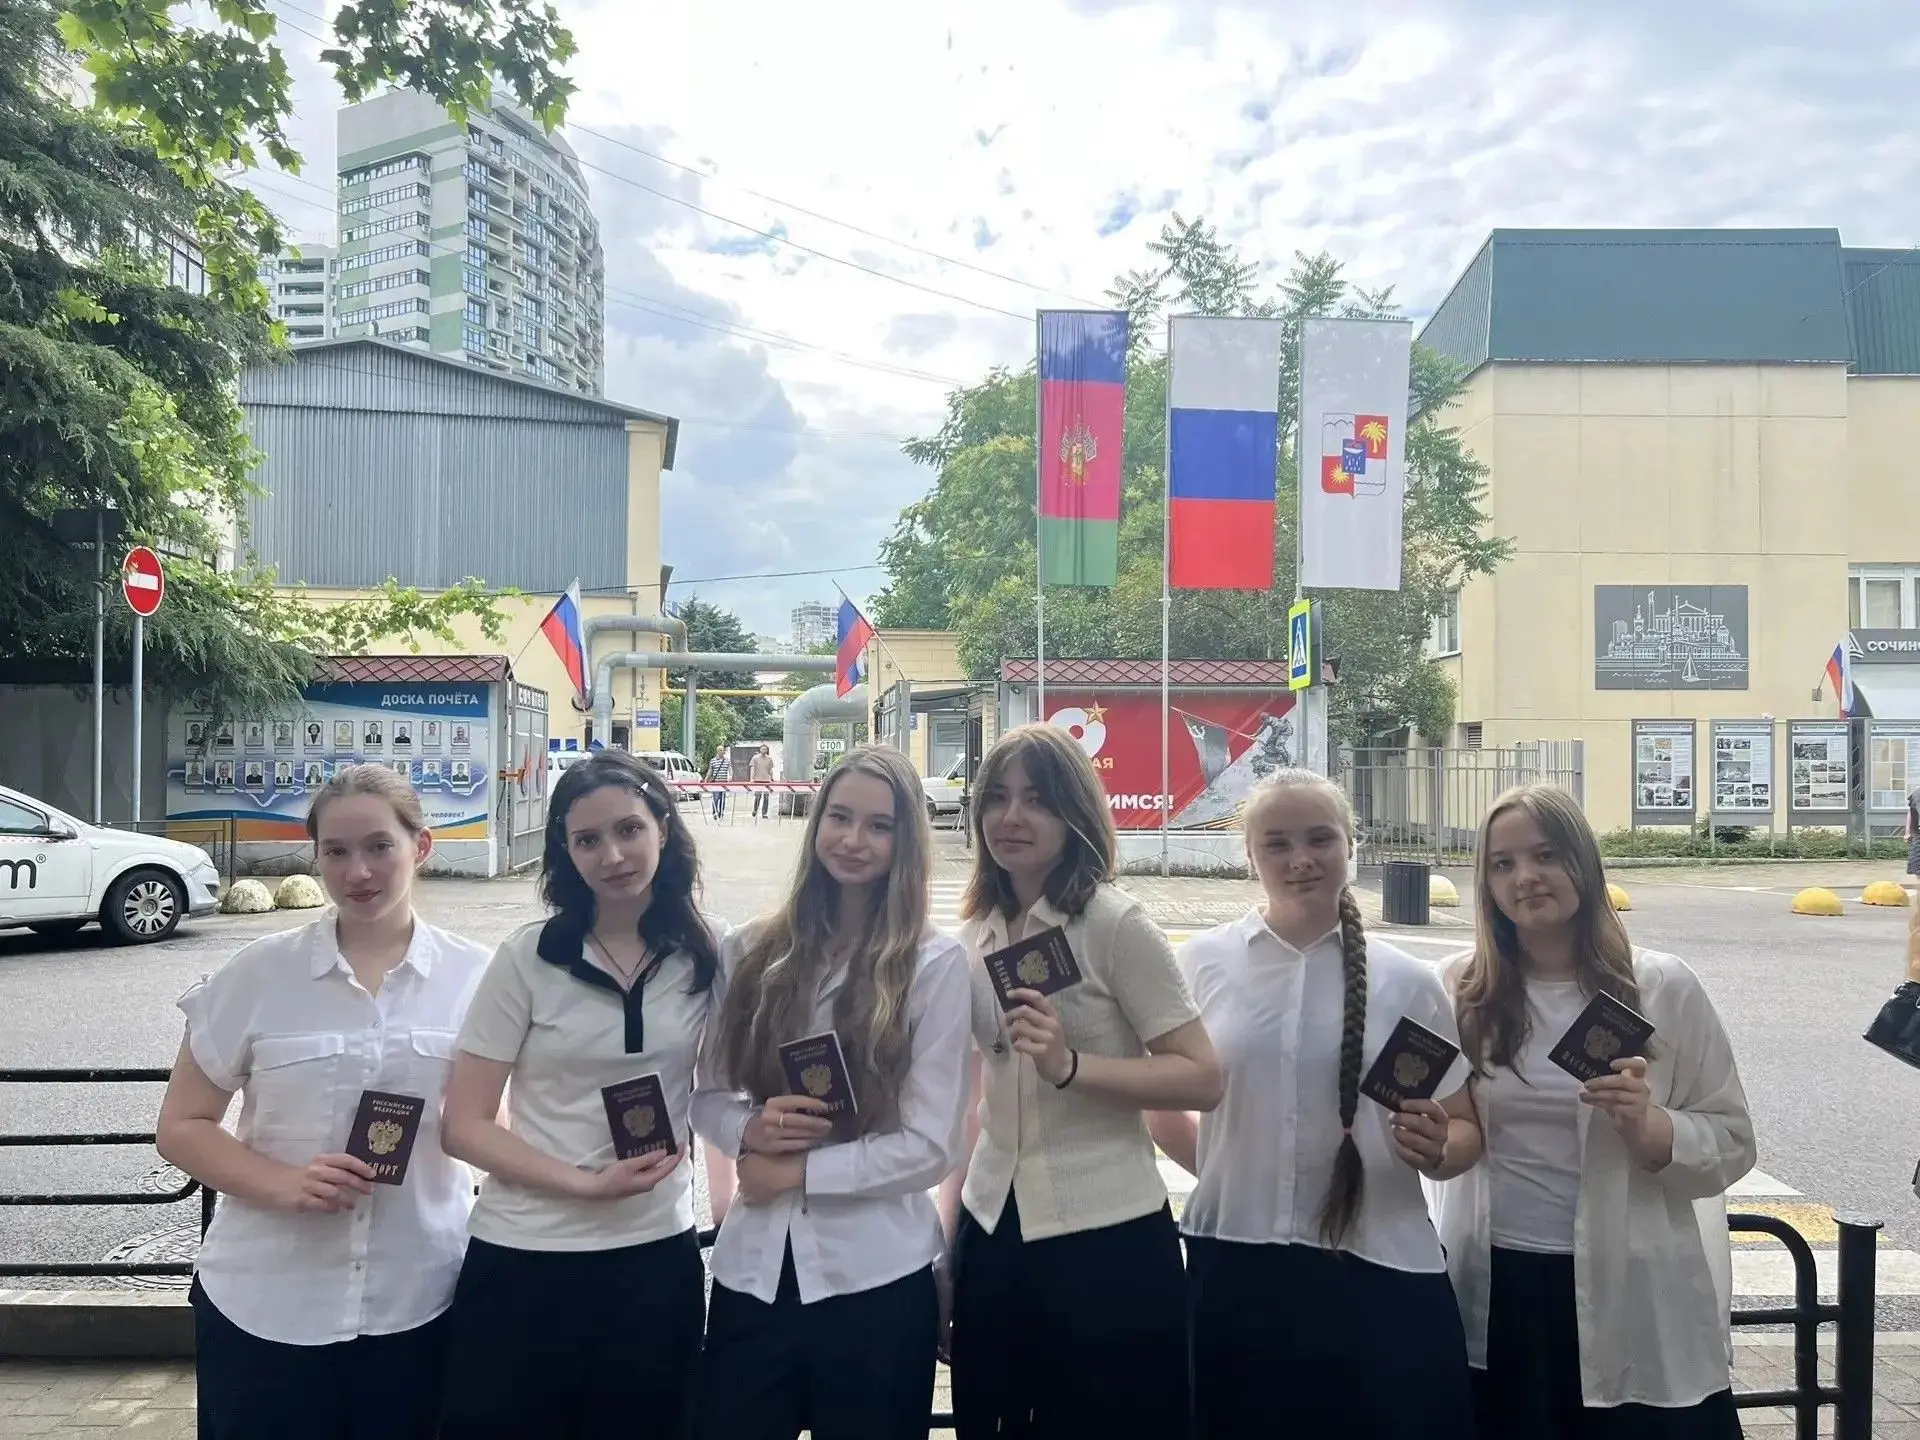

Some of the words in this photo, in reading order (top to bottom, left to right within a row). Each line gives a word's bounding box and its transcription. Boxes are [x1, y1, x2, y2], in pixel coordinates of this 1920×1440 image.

[1867, 640, 1920, 651] СОЧИН
[381, 694, 425, 707] ДОСКА
[428, 692, 479, 705] ПОЧЁТА
[820, 741, 841, 750] СТОП
[1093, 757, 1114, 769] АЯ
[1105, 794, 1174, 810] ИМСЯ!
